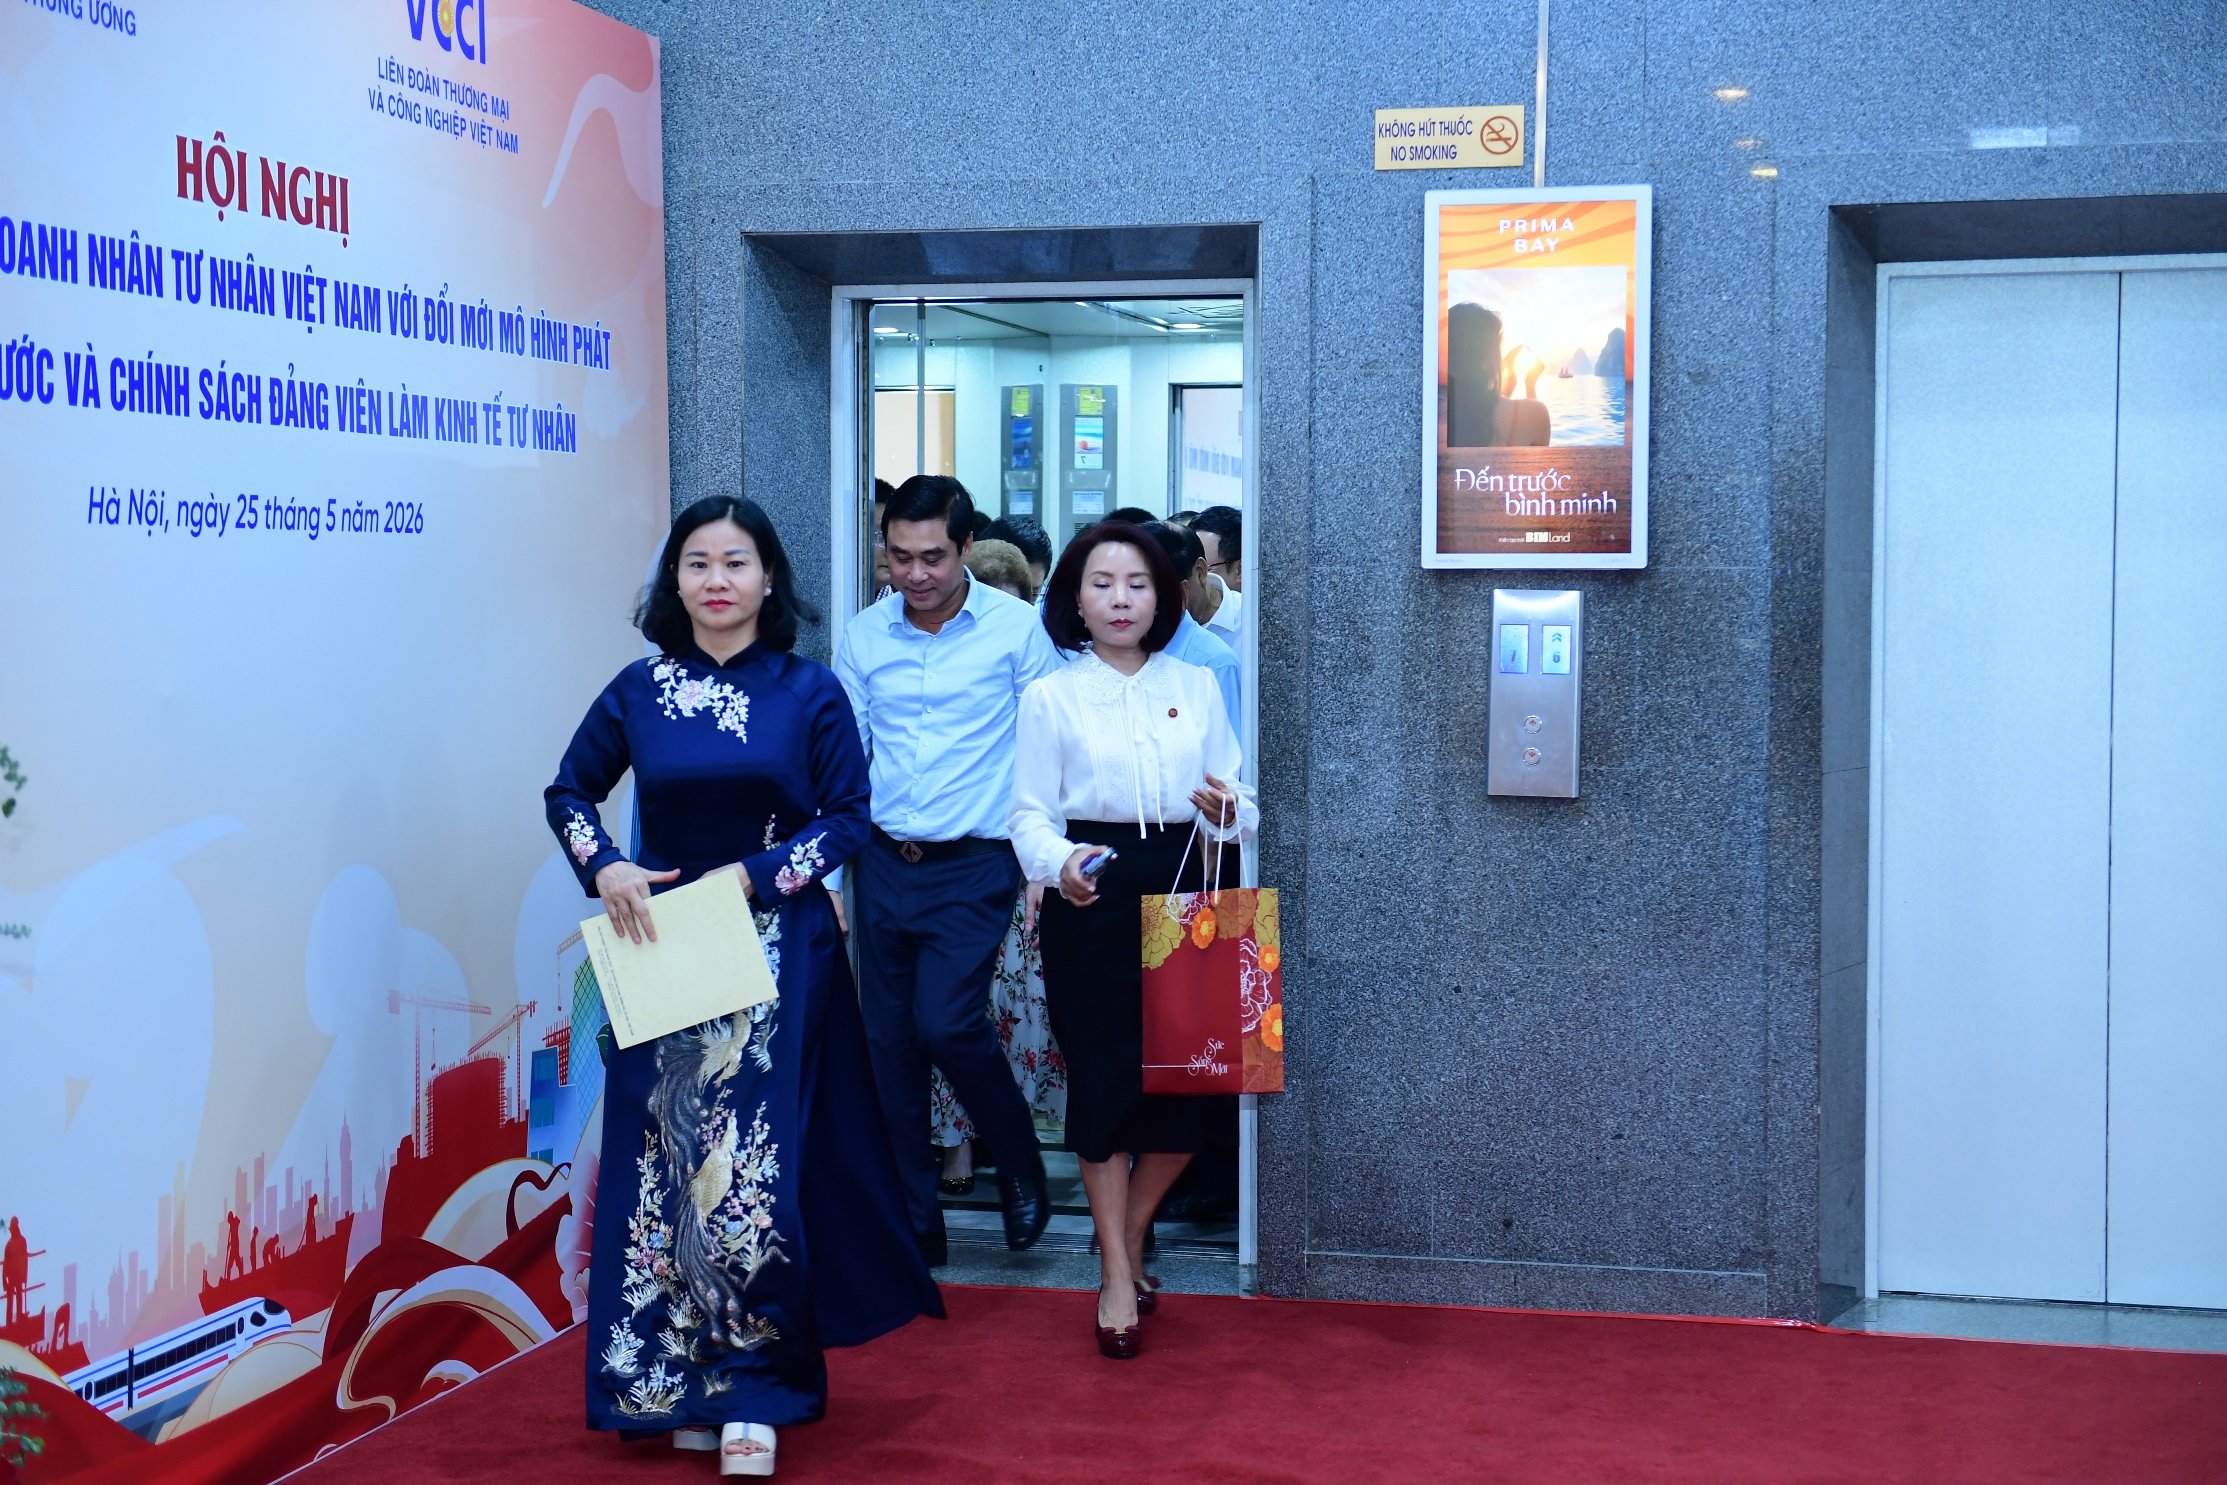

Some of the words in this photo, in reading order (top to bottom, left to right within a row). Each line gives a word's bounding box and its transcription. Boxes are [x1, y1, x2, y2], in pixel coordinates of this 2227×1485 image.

[406, 0, 486, 65] VCCI
[378, 55, 404, 86] LIÊN
[408, 67, 440, 97] ĐOÀN
[443, 79, 488, 113] THƯƠNG
[491, 95, 510, 123] MẠI
[368, 85, 385, 113] VÀ
[388, 92, 422, 125] CÔNG
[425, 110, 467, 140] NGHIỆP
[470, 119, 493, 149] VIỆT
[496, 129, 519, 154] NAM
[1379, 119, 1416, 138] KHÔNG
[1419, 118, 1436, 137] HÚT
[1439, 114, 1473, 136] THUỐC
[1391, 146, 1406, 161] NO
[1409, 144, 1457, 161] SMOKING
[176, 130, 248, 222] HỘI
[259, 156, 350, 249] NGHỊ
[1499, 217, 1575, 234] PRIMA
[1514, 237, 1560, 253] BAY
[88, 230, 163, 298] NHÂN
[171, 249, 204, 304] TƯ
[210, 253, 275, 316] NHÂN
[282, 264, 327, 334] VIỆT
[334, 280, 381, 333] NAM
[387, 283, 418, 339] VỚI
[424, 283, 454, 345] ĐỔI
[460, 298, 494, 351] MỚI
[499, 305, 525, 356] MÔ
[530, 309, 568, 363] HÌNH
[572, 320, 611, 370] PHÁT
[64, 342, 101, 409] VÀ
[110, 350, 190, 417] CHÍNH
[199, 360, 261, 424] SÁCH
[269, 362, 329, 430] ĐẢNG
[335, 378, 382, 435] VIÊN
[388, 383, 428, 440] LÀM
[435, 397, 477, 444] KINH
[482, 391, 502, 446] TẾ
[507, 403, 528, 449] TƯ
[532, 403, 576, 453] NHÂN
[1454, 466, 1503, 491] Đến
[1508, 468, 1571, 492] trước
[88, 486, 121, 525] Hà
[128, 488, 169, 537] Nội,
[177, 492, 230, 537] ngày
[235, 493, 259, 529] 25
[265, 496, 320, 540] tháng
[326, 498, 336, 531] 5
[341, 500, 379, 532] năm
[384, 501, 423, 534] 2026
[1505, 491, 1555, 516] bình
[1561, 490, 1617, 515] minh
[1553, 651, 1560, 663] 6
